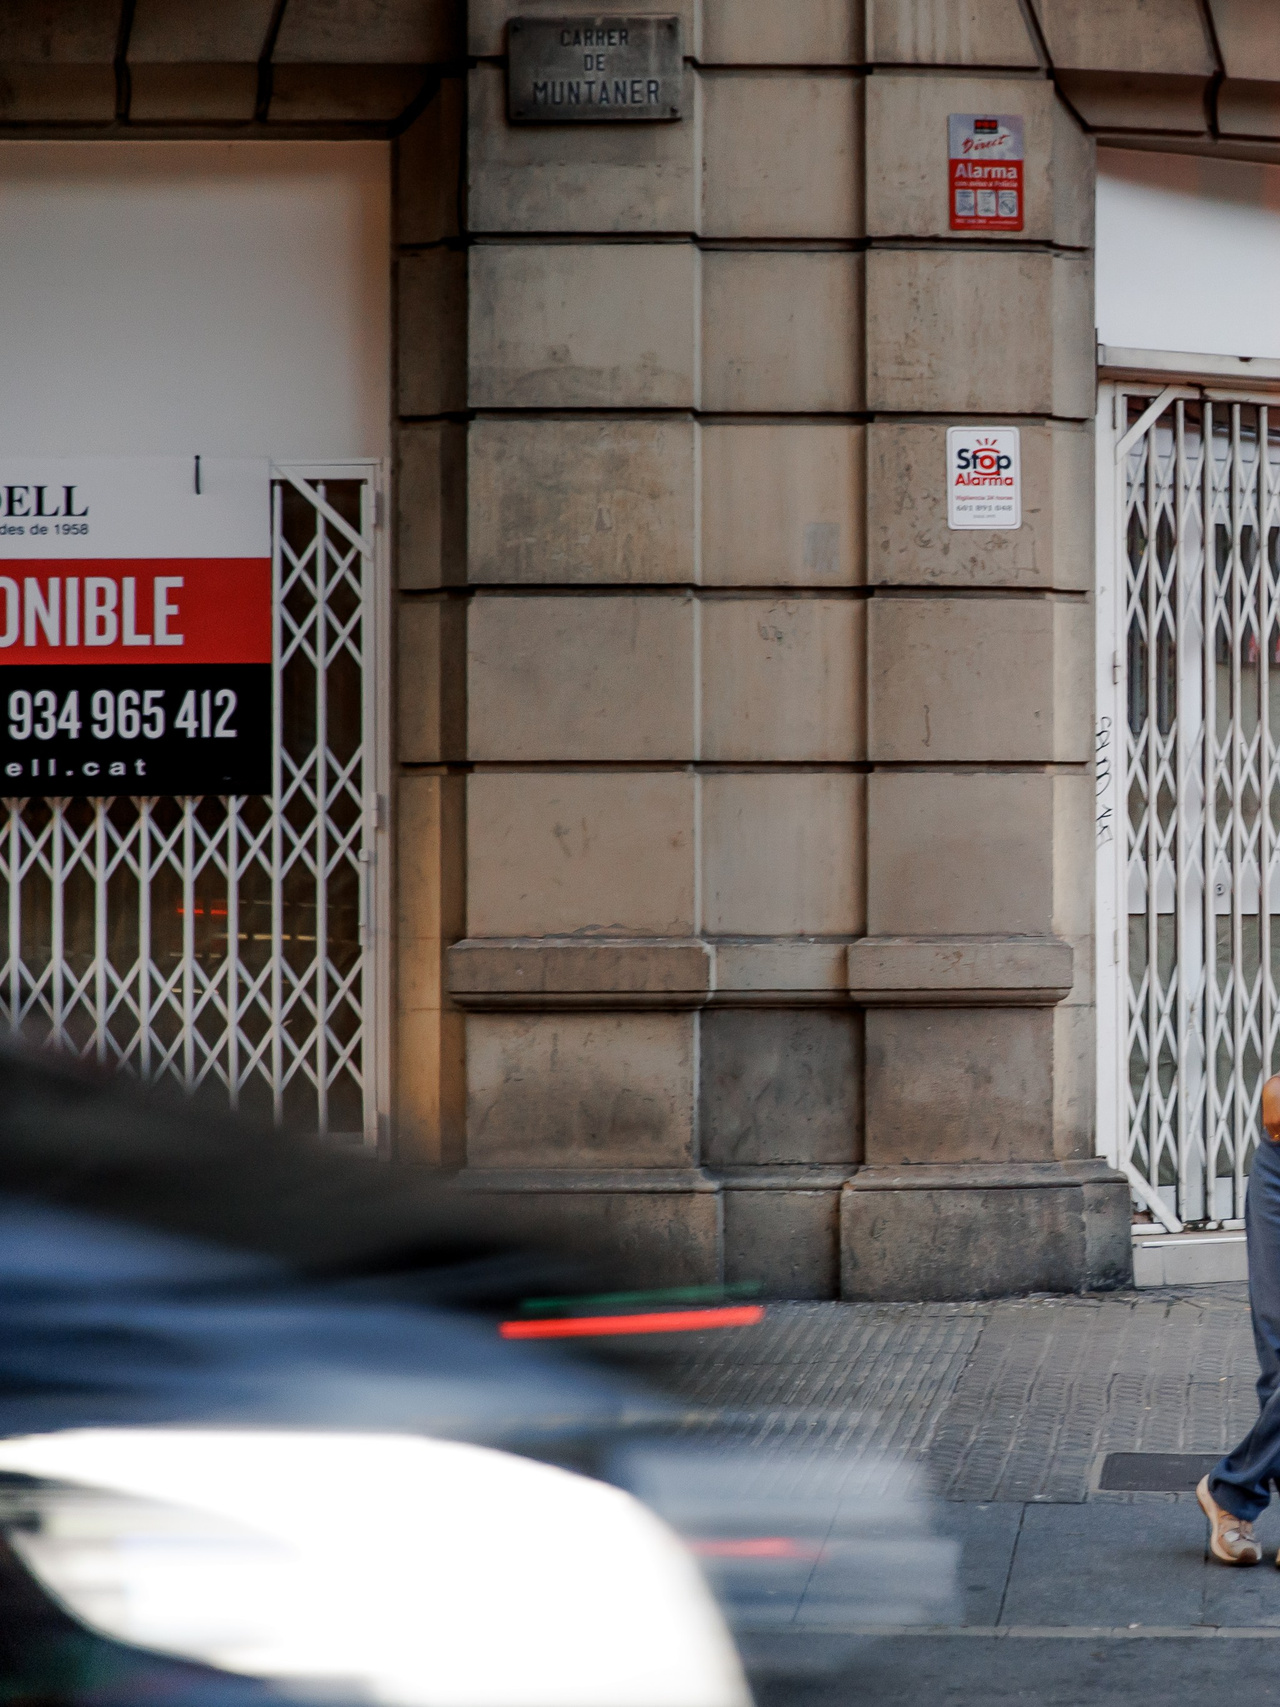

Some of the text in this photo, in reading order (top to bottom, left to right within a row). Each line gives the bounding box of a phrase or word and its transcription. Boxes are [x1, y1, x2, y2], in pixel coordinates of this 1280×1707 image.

[560, 28, 629, 47] CARRER
[583, 53, 606, 71] DE
[532, 79, 660, 105] MUNTANER
[955, 163, 1017, 179] Alarma
[956, 447, 1012, 476] Stop
[955, 473, 1013, 486] Alarma
[0, 485, 90, 517] ELL
[29, 523, 49, 536] de
[54, 523, 90, 536] 1958
[8, 688, 237, 740] 934 965 412
